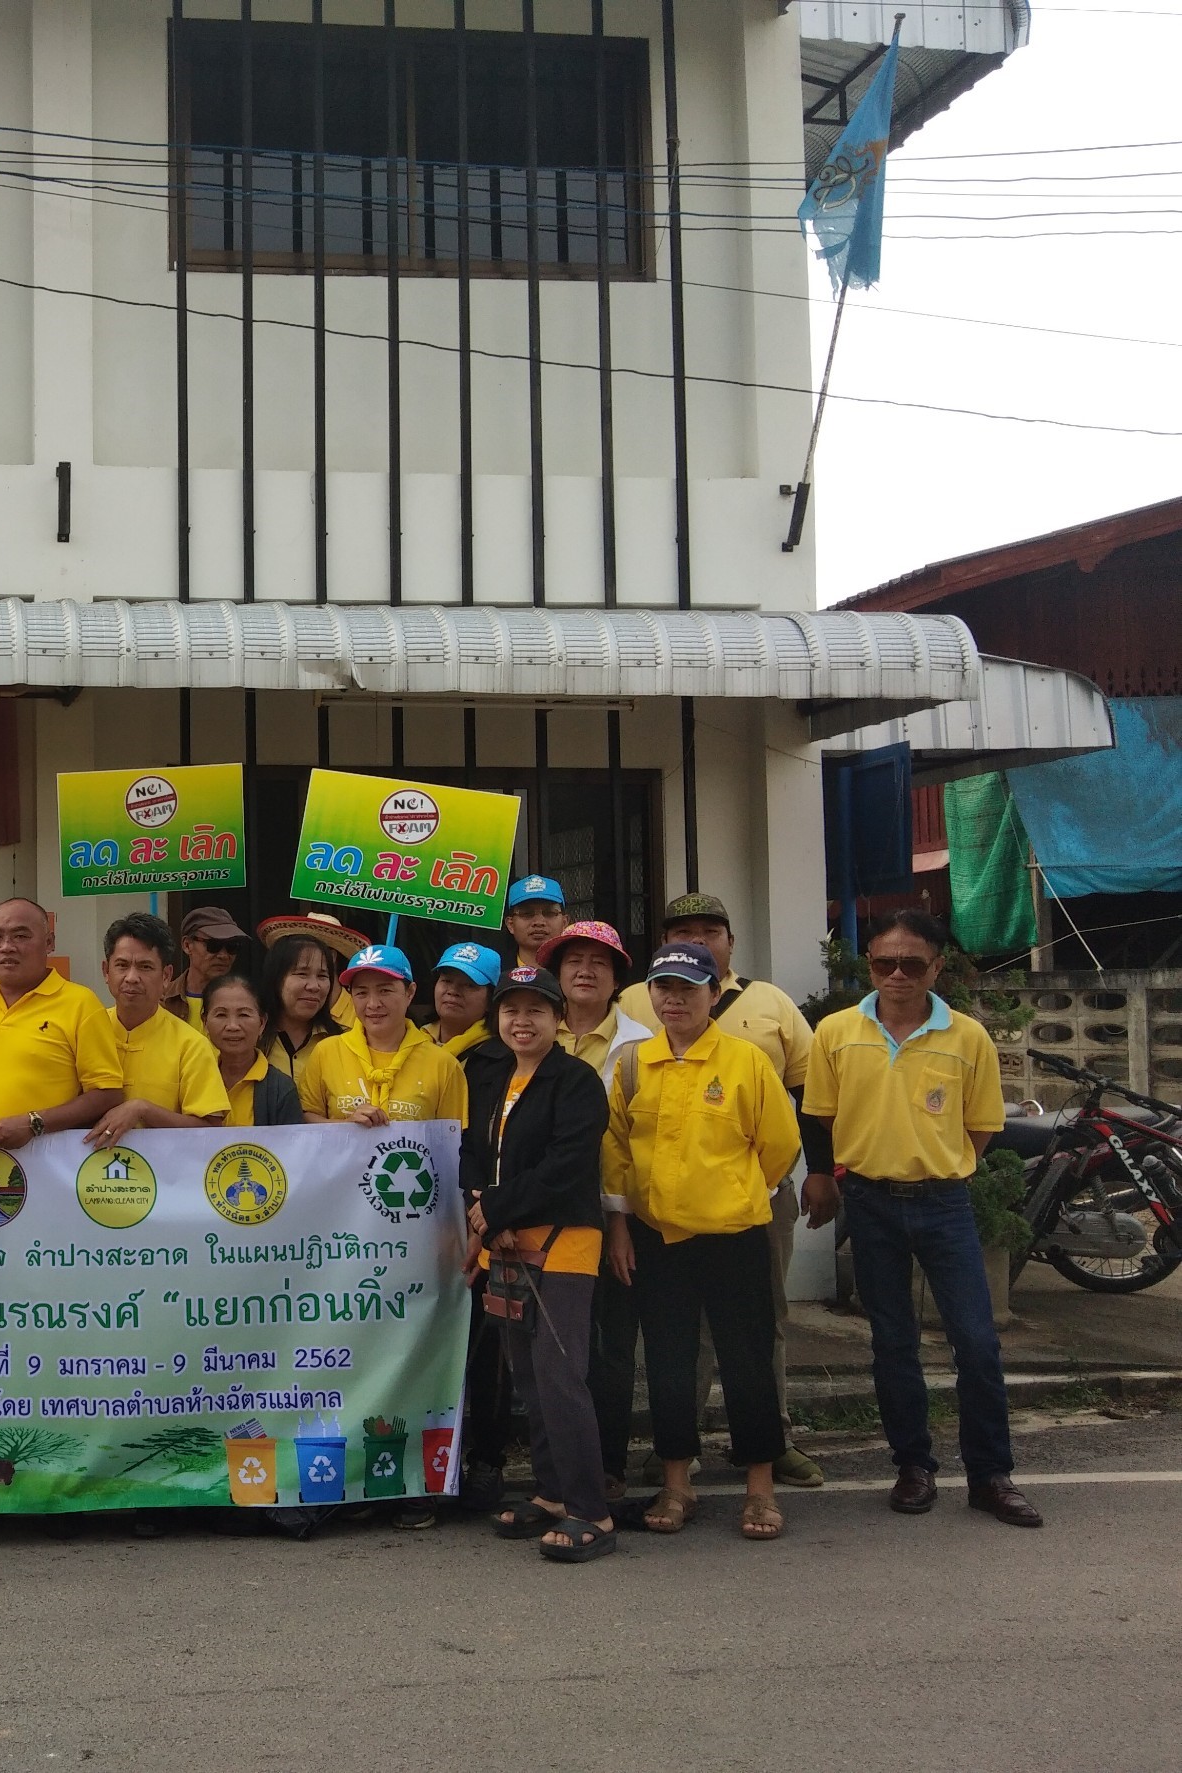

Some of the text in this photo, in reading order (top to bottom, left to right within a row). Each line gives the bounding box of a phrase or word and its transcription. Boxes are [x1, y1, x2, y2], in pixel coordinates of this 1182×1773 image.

[69, 824, 237, 869] ลด ละ เลิก
[82, 868, 230, 888] การใช้โฟมบรรจุอาหาร
[305, 842, 500, 897] ลด ละ เลิก
[314, 880, 486, 917] การใช้โฟมบรรจุอาหาร
[374, 1136, 430, 1157] Reduce
[1109, 1135, 1161, 1203] GALAXY
[358, 1172, 401, 1223] Recycle
[26, 1240, 188, 1268] ลำปางสะอาด
[205, 1230, 408, 1269] ในแผนปฏิบัติการ
[27, 1354, 42, 1375] 9
[58, 1353, 146, 1376] มกราคม
[173, 1353, 187, 1374] 9
[202, 1344, 276, 1372] มีนาคม
[294, 1348, 352, 1368] 2562
[40, 1385, 342, 1417] เทศบาลตำบลห้างฉัตรแม่ตาล
[230, 1422, 247, 1434] NEWS
